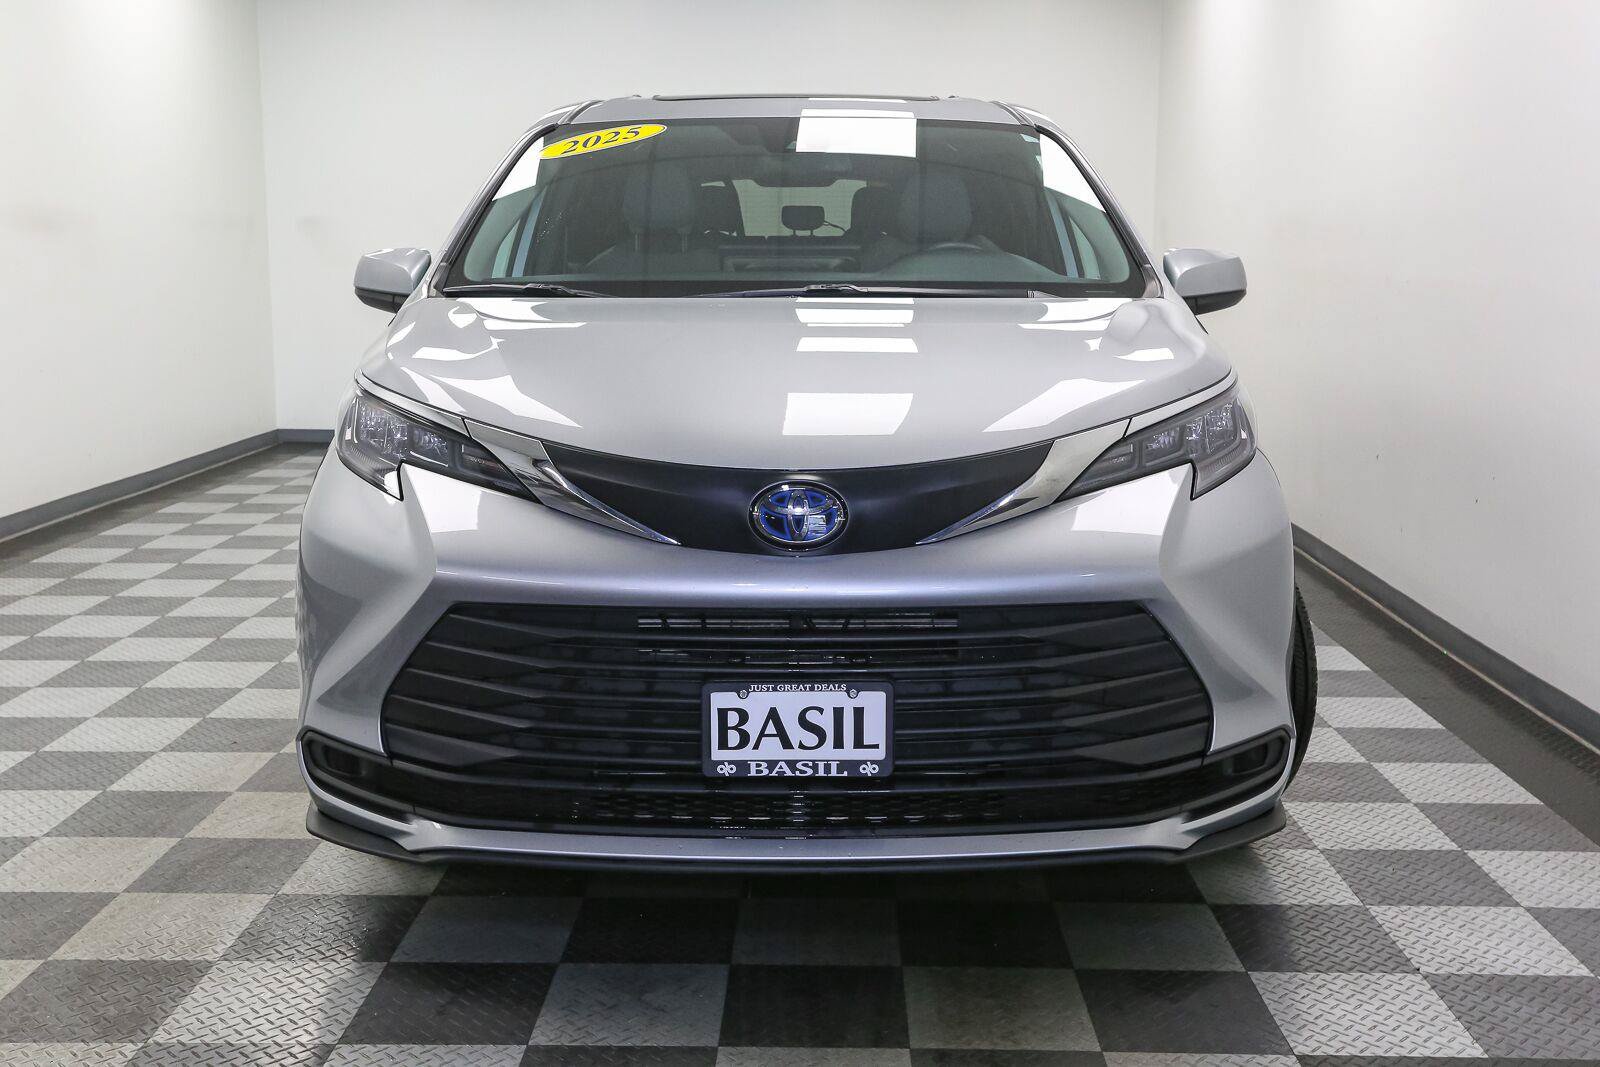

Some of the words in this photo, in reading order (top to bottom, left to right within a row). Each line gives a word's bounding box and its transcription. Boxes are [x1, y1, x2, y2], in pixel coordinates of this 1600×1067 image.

[561, 126, 641, 155] 2025
[748, 684, 774, 692] JUST
[777, 684, 812, 692] GREAT
[717, 706, 880, 751] BASIL
[747, 761, 848, 776] BASIL
